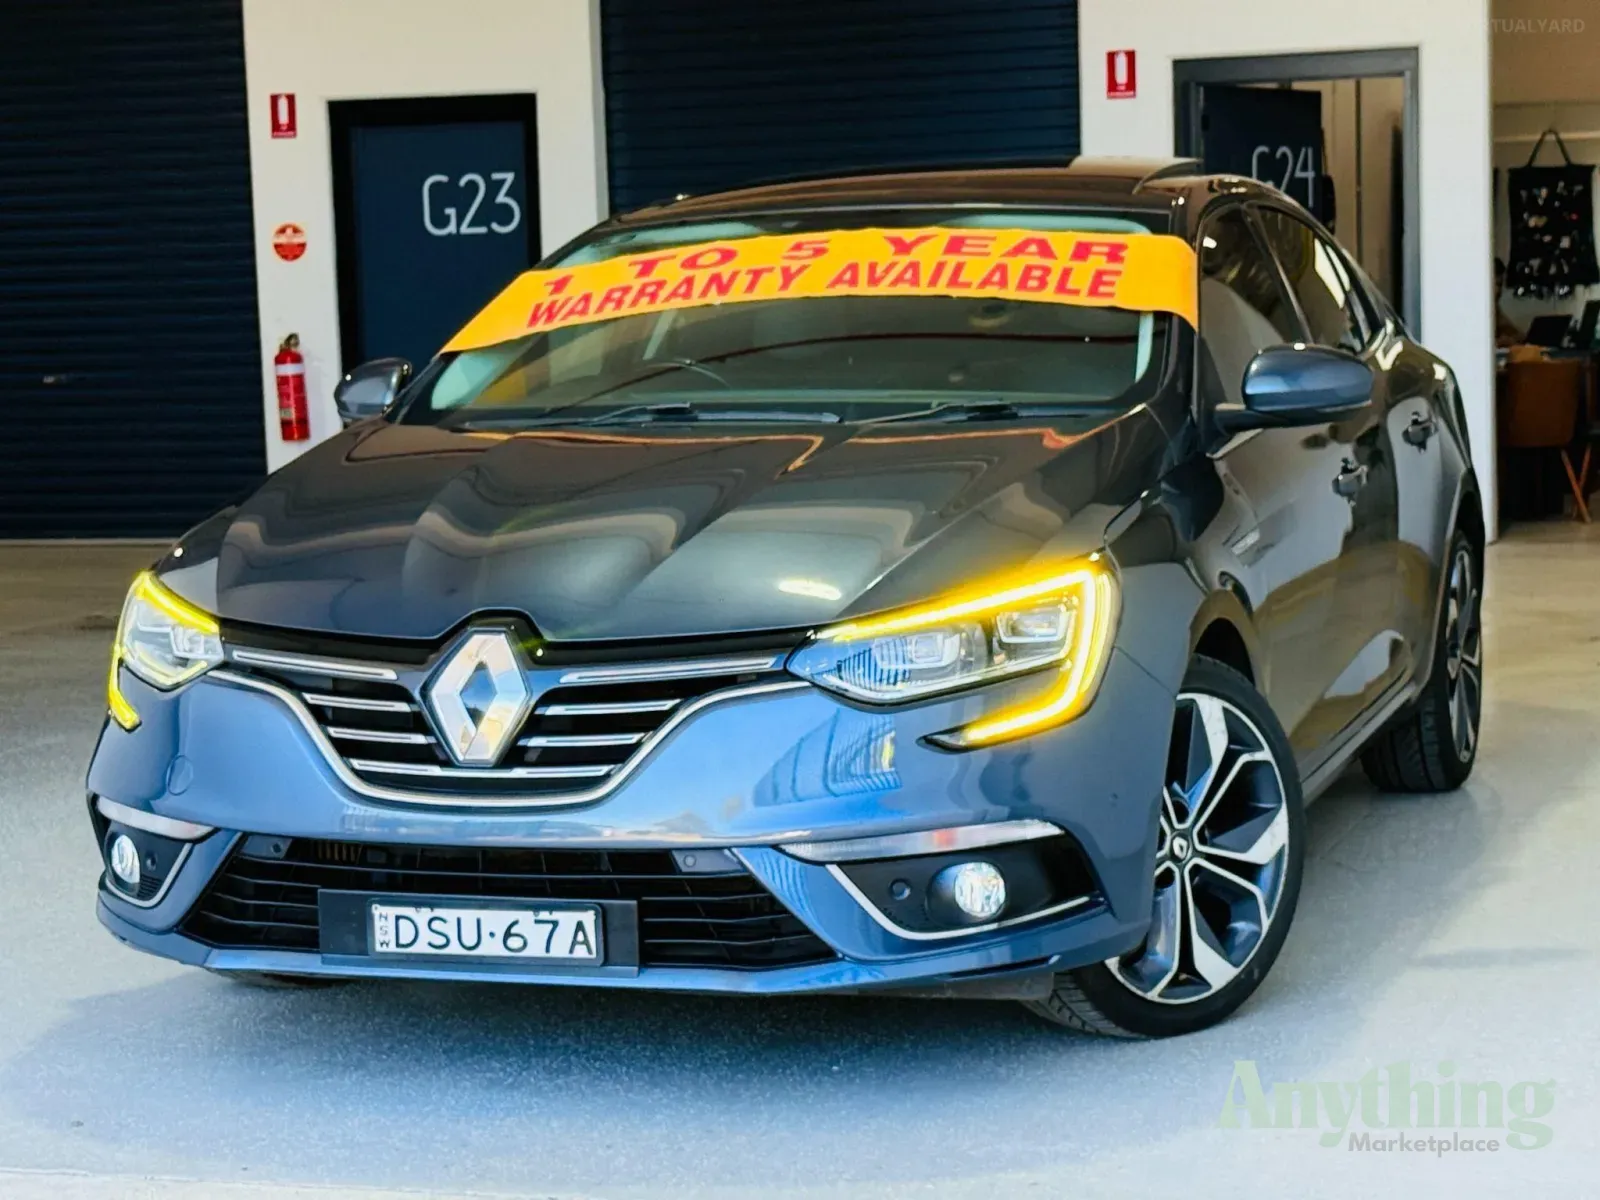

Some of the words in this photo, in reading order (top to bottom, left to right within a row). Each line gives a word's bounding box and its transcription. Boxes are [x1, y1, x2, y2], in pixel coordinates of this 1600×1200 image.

[422, 171, 521, 236] G23
[526, 264, 812, 329] WARRANTY
[826, 260, 1122, 299] AVAILABLE
[543, 274, 575, 296] 1
[628, 247, 739, 279] TO
[781, 240, 831, 261] 5
[883, 234, 1129, 265] YEAR
